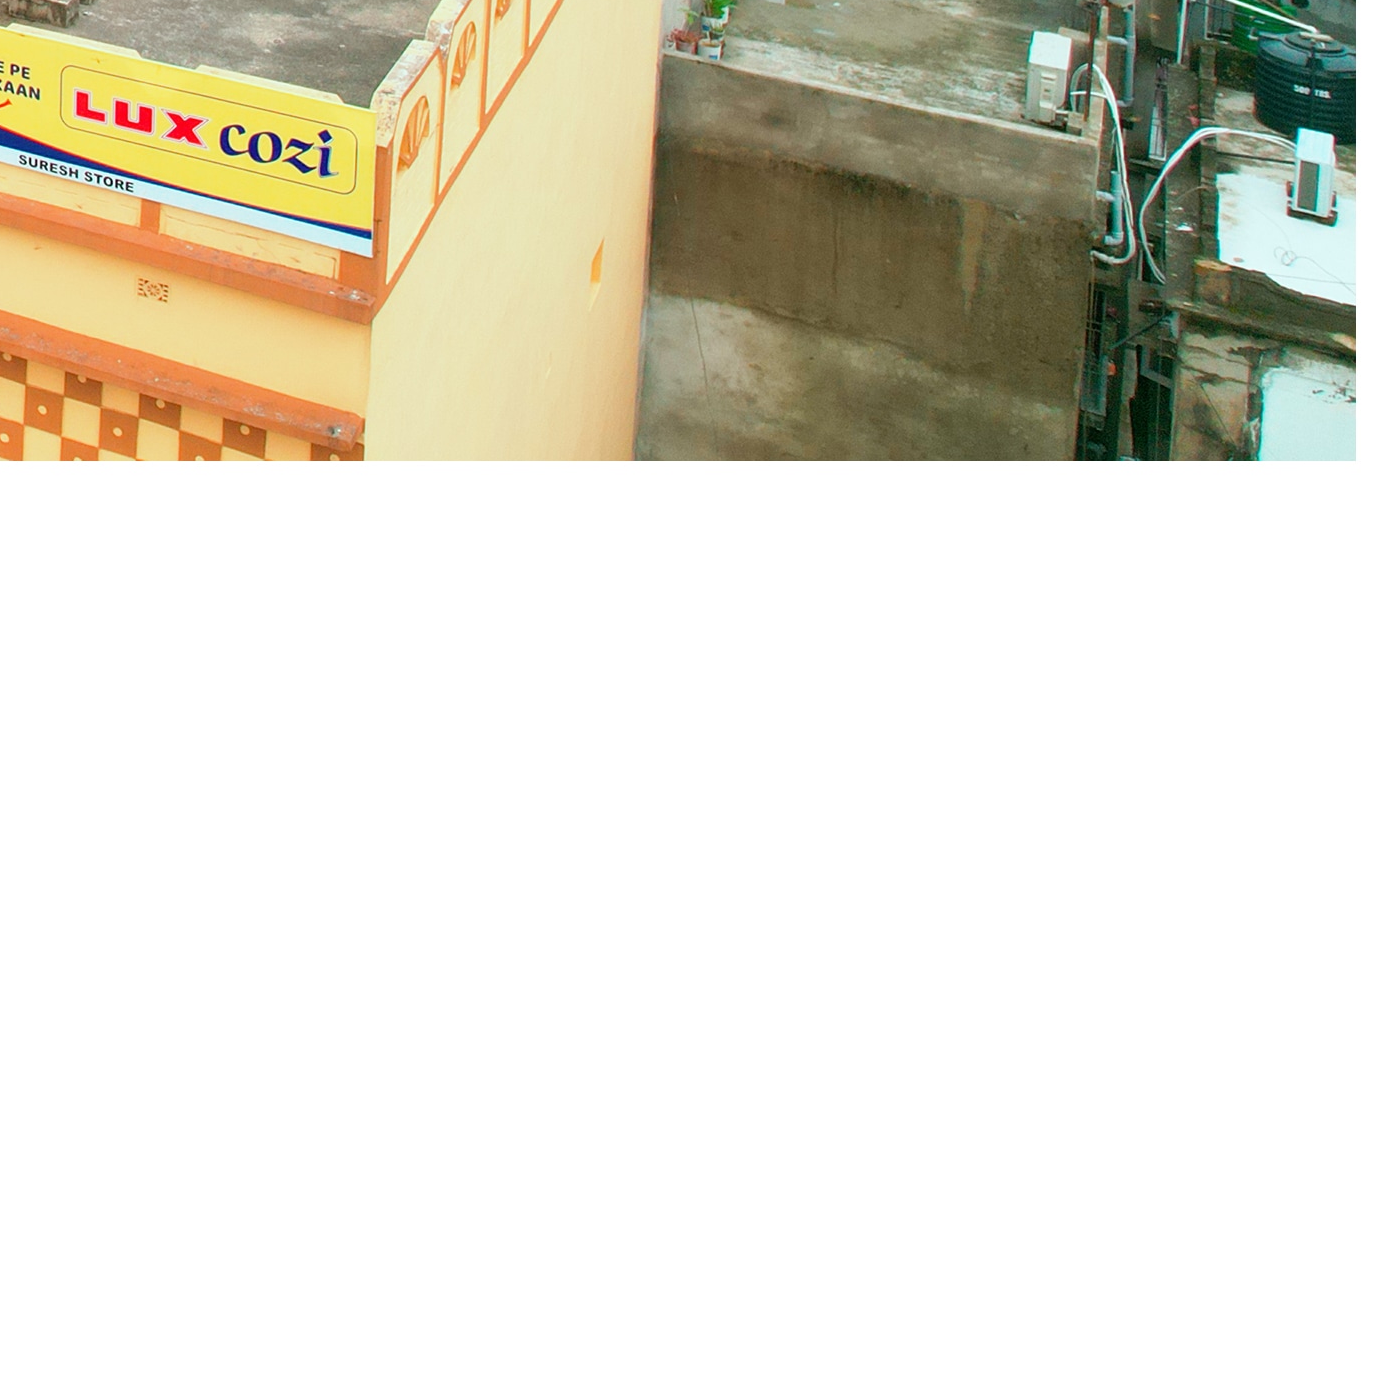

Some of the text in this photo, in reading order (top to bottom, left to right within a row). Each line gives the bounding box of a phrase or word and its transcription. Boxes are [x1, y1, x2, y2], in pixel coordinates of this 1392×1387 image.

[9, 63, 31, 80] PE
[73, 88, 340, 179] LUX cozi
[18, 154, 135, 193] SURESH STORE
